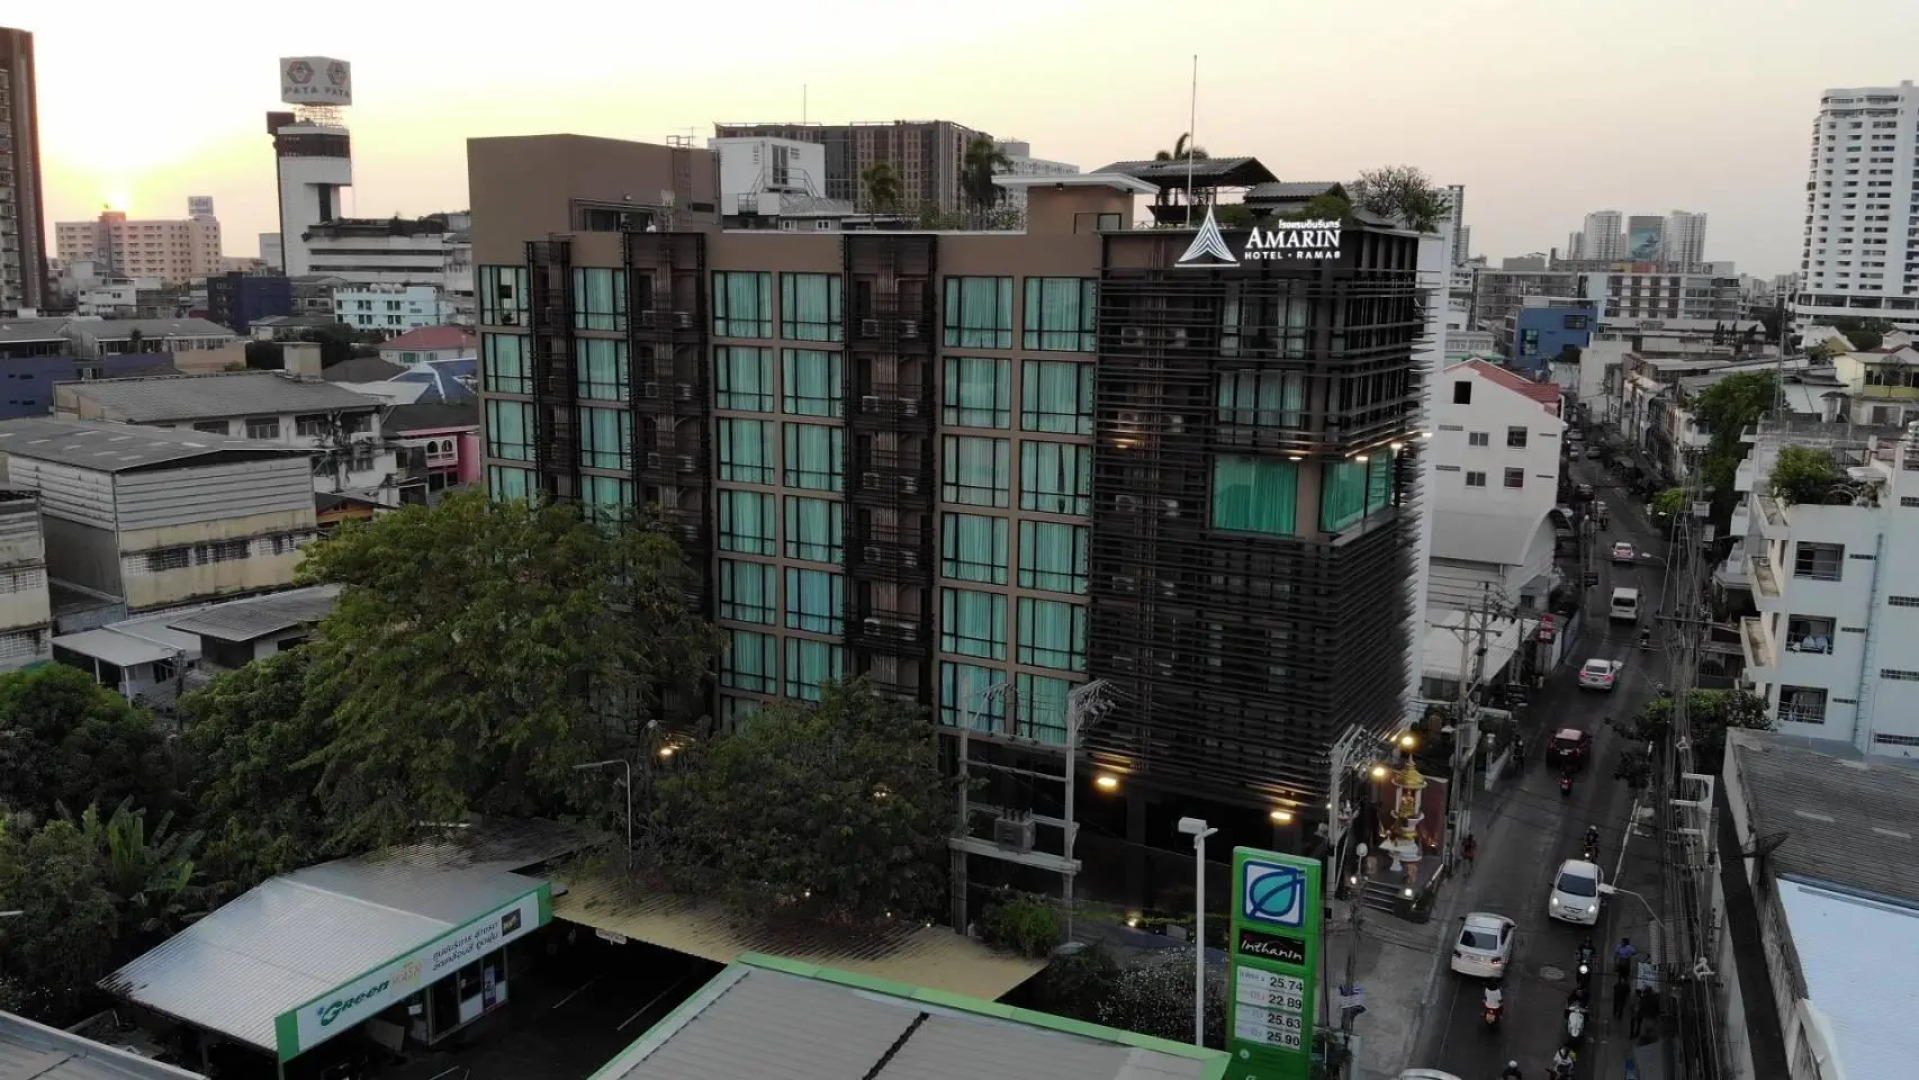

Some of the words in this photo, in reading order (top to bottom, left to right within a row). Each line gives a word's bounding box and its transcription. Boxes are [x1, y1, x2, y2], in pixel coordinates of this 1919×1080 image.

[1245, 227, 1342, 249] AMARIN
[1244, 251, 1283, 259] HOTEL
[1241, 939, 1302, 961] Inthanin
[1269, 976, 1303, 992] 25.74
[321, 980, 390, 1026] Green
